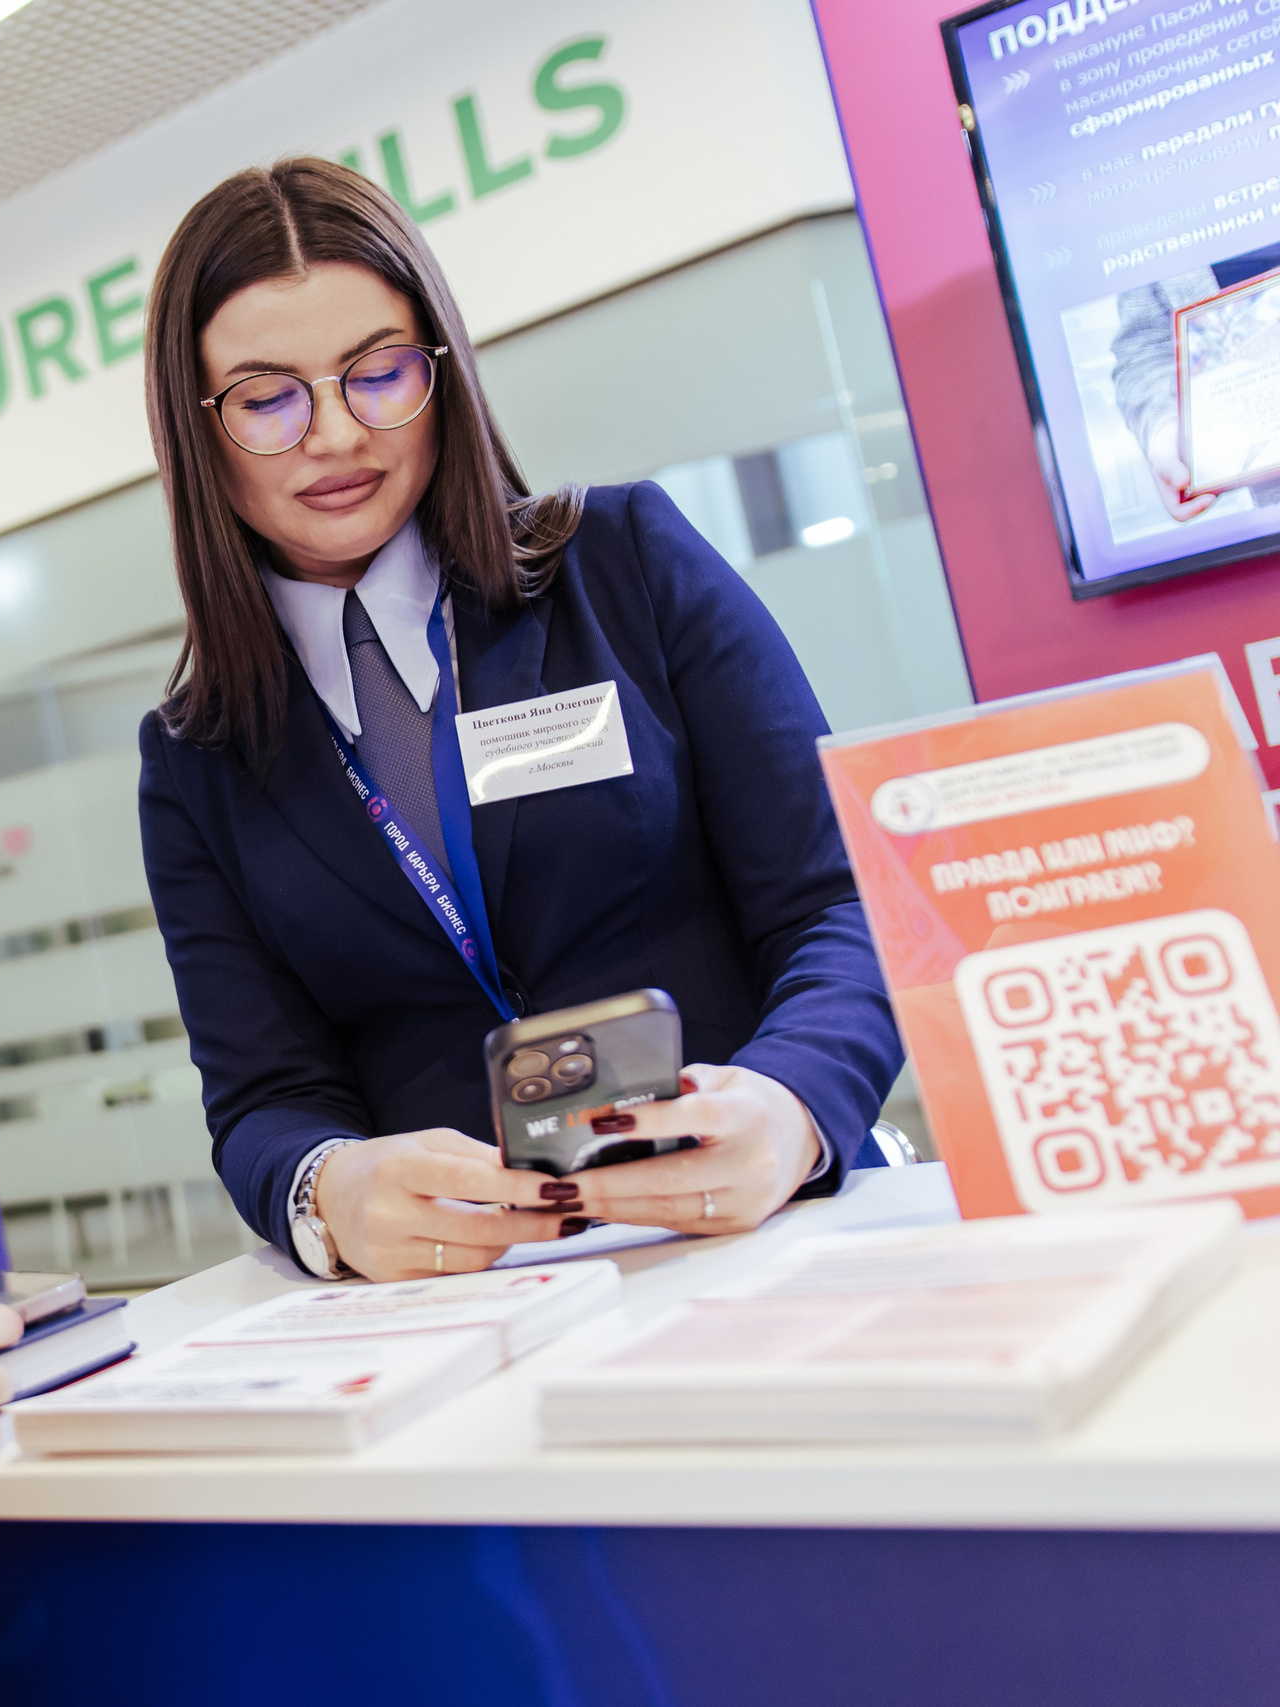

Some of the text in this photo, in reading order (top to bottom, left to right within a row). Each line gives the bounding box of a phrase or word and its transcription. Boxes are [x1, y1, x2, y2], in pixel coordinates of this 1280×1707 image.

[1054, 0, 1213, 72] накануне Пасхи
[1060, 78, 1072, 93] в
[1077, 58, 1121, 87] зону
[1127, 8, 1249, 68] проведения
[1064, 45, 1220, 116] маскировочных
[1068, 49, 1275, 138] сформированных
[1081, 167, 1094, 182] в
[1099, 152, 1136, 176] мае
[1141, 109, 1254, 162] передали
[1087, 133, 1261, 204] мотострелковому
[1102, 206, 1266, 276] родственники
[472, 694, 607, 730] Цветкова Яна Олеговн
[480, 730, 531, 747] помощник
[533, 719, 579, 735] мирового
[485, 733, 576, 759] судебного участка
[346, 766, 370, 800] БИЗНЕС
[528, 759, 574, 774] г.Москвы
[383, 821, 467, 935] ГОРОД КАРЬЕРА БИЗНЕС
[929, 815, 1196, 894] ПРАВДА ИЛИ МИФ?
[985, 860, 1163, 921] ПОИГРАЕМ?
[526, 1116, 559, 1139] WE
